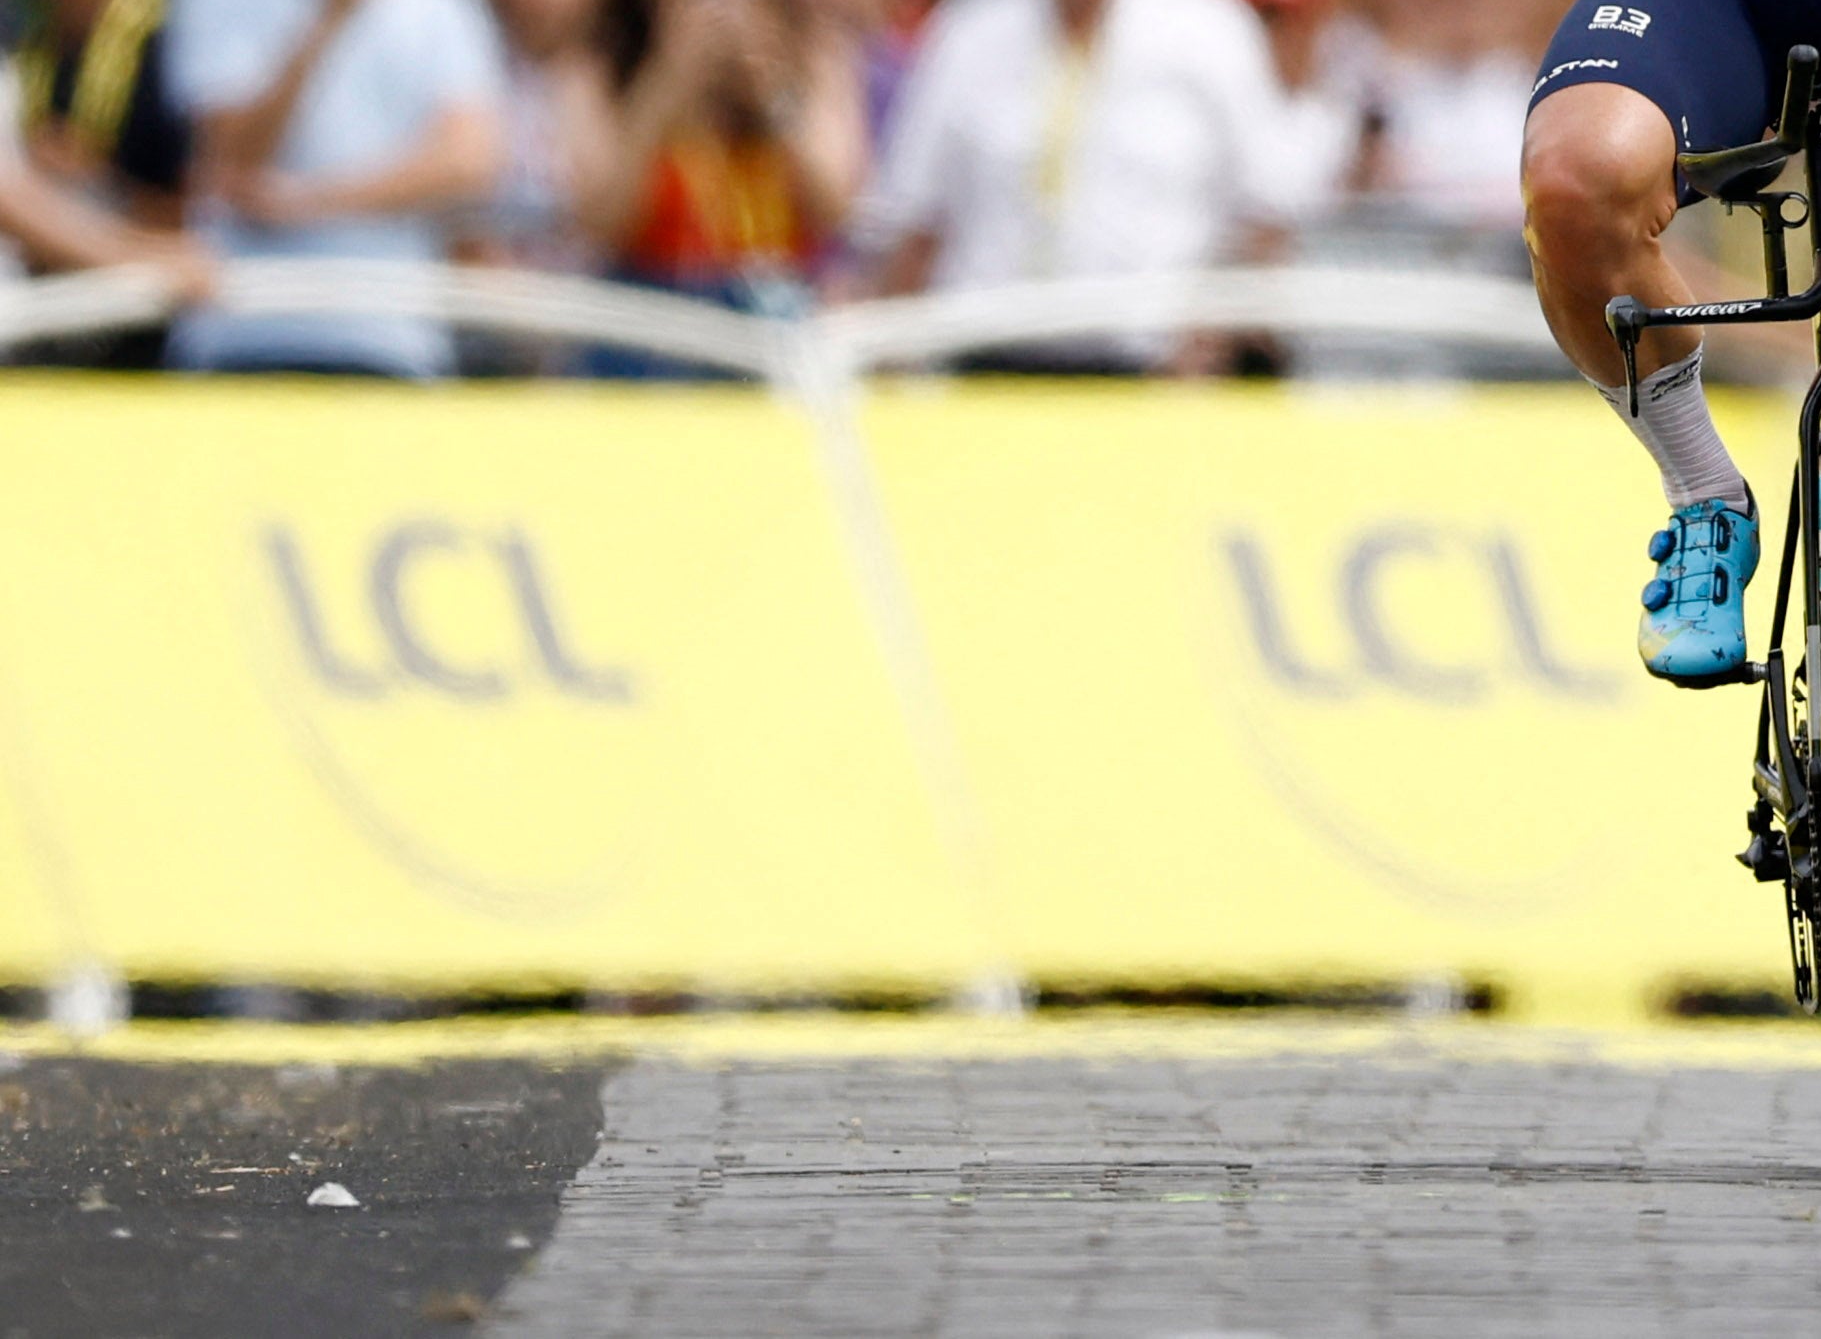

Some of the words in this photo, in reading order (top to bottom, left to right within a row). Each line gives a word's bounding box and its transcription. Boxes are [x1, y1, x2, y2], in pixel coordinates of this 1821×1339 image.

[1587, 21, 1645, 39] BIEMME
[1592, 5, 1652, 32] B3
[262, 516, 634, 705] LCL
[1222, 522, 1625, 708] LCL
